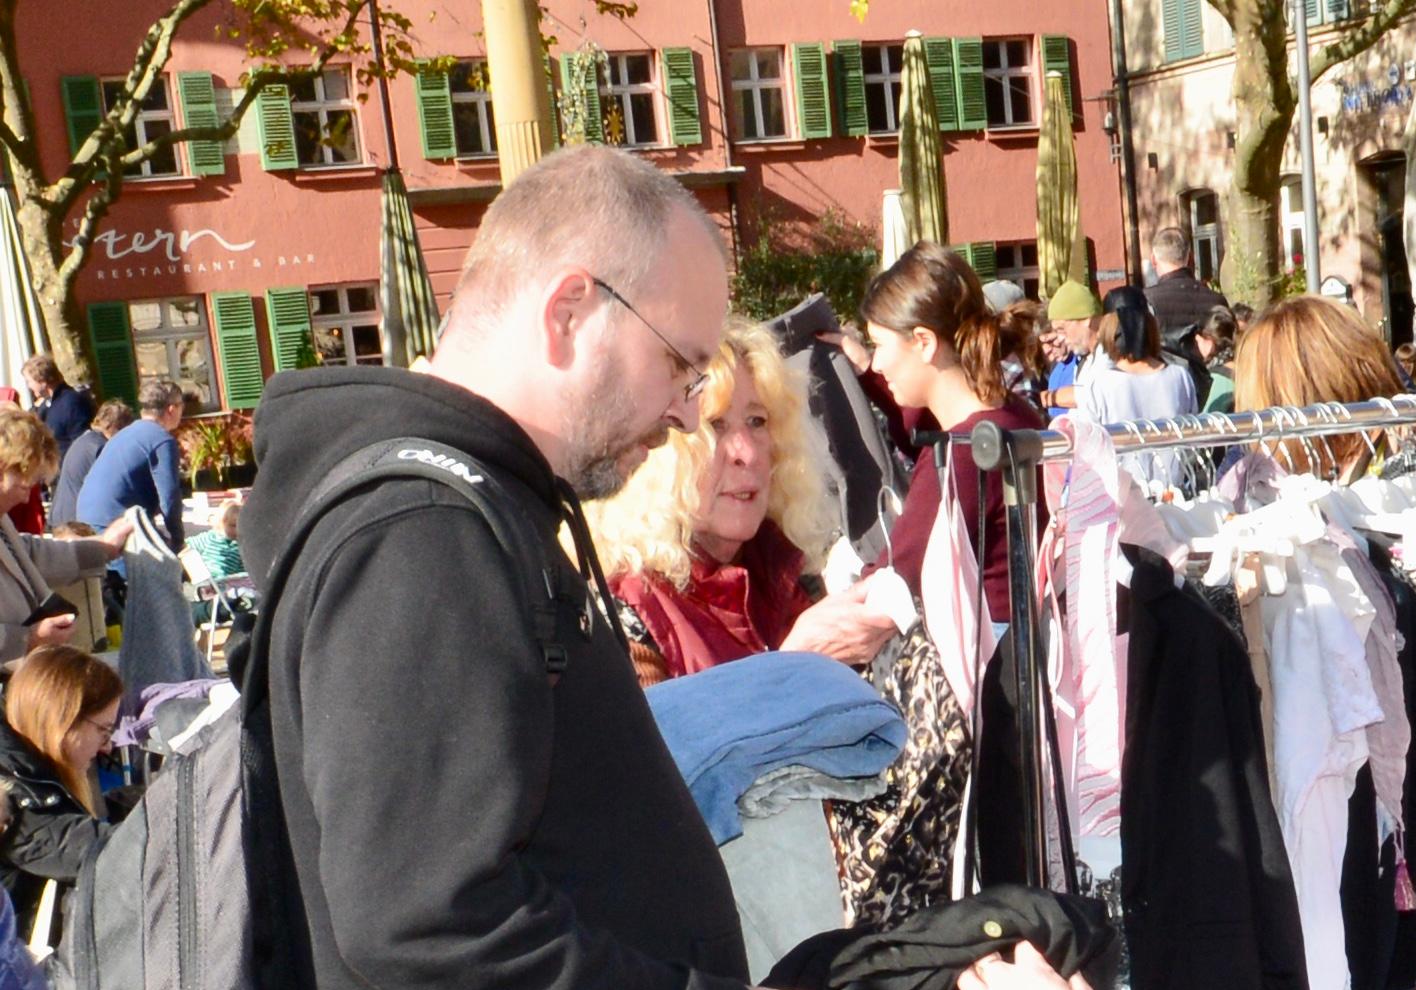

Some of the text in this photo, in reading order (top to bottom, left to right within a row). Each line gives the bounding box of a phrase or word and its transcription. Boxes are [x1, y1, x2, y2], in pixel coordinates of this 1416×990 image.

[97, 254, 316, 280] RESTAURANT & BAR
